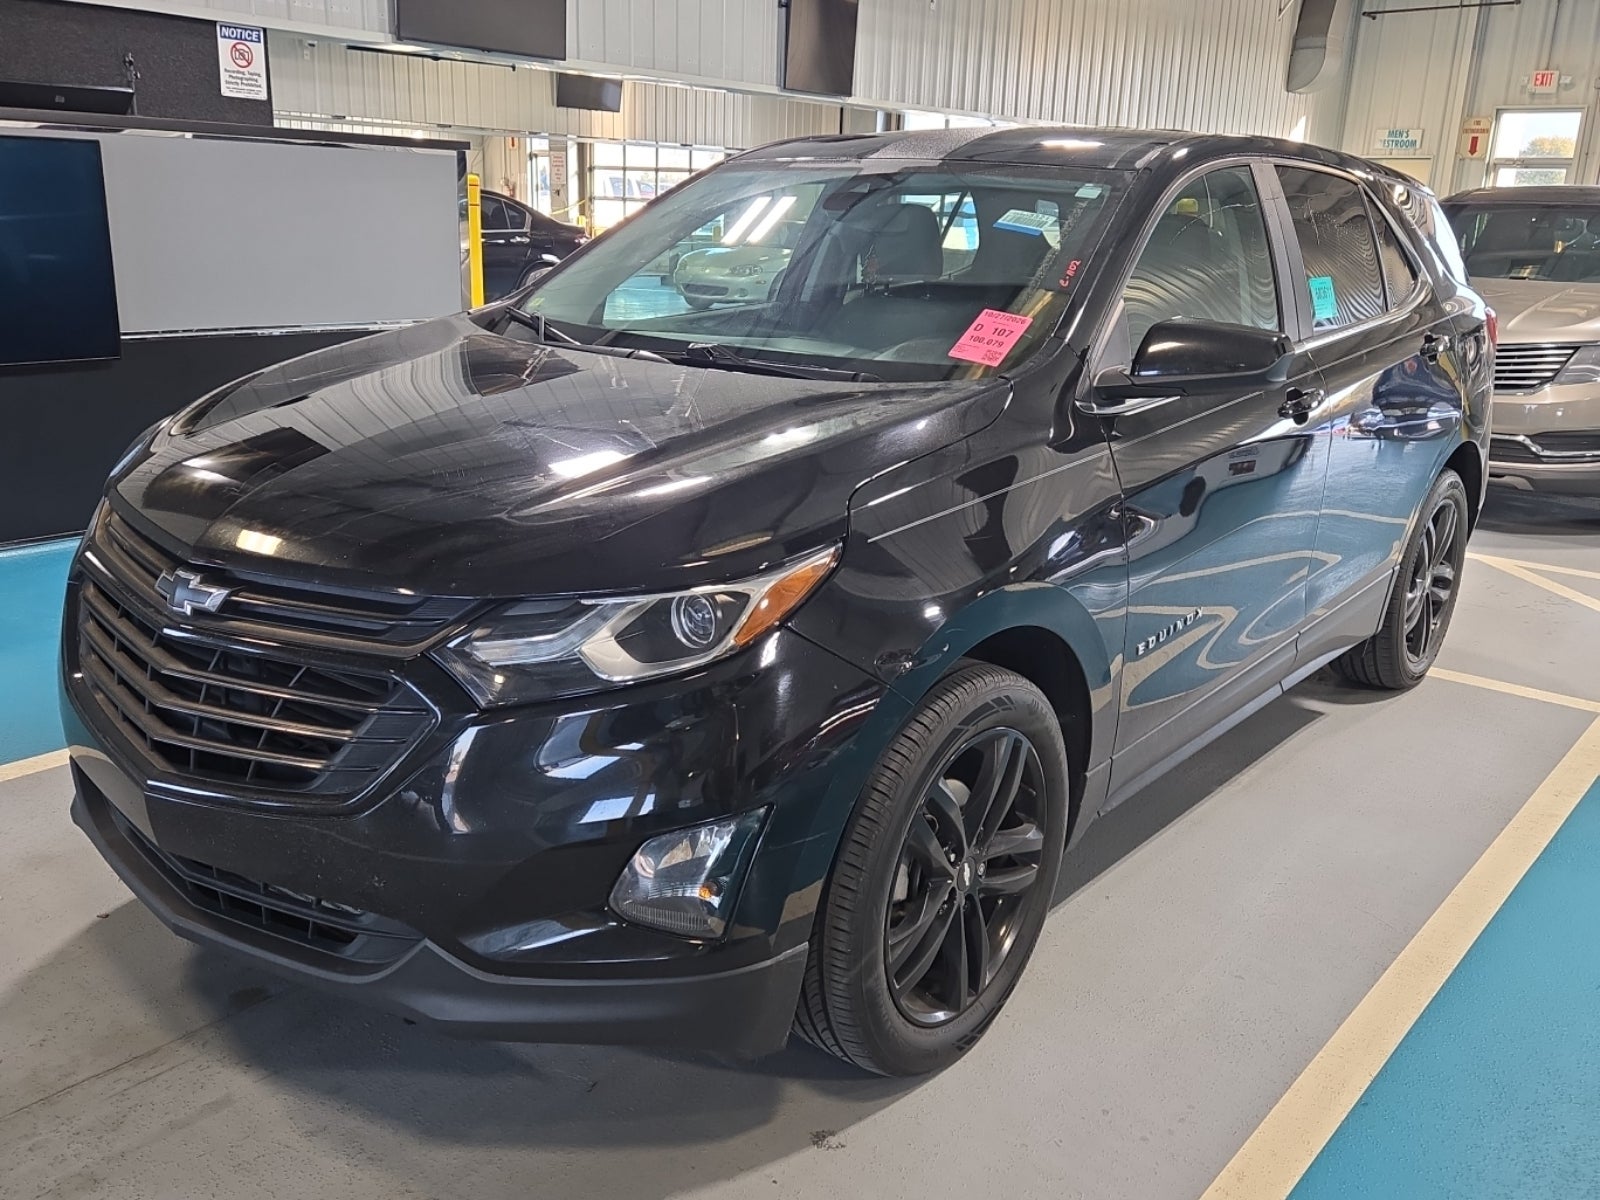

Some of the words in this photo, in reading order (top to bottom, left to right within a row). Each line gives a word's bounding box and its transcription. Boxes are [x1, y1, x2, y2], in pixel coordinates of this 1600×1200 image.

[221, 26, 259, 42] NOTICE
[1534, 72, 1553, 87] EXIT
[1387, 129, 1410, 139] MEN'S
[1380, 138, 1417, 149] ESTROOM
[974, 323, 984, 332] D
[992, 327, 1014, 338] 107
[1137, 606, 1204, 656] EQUINOX
